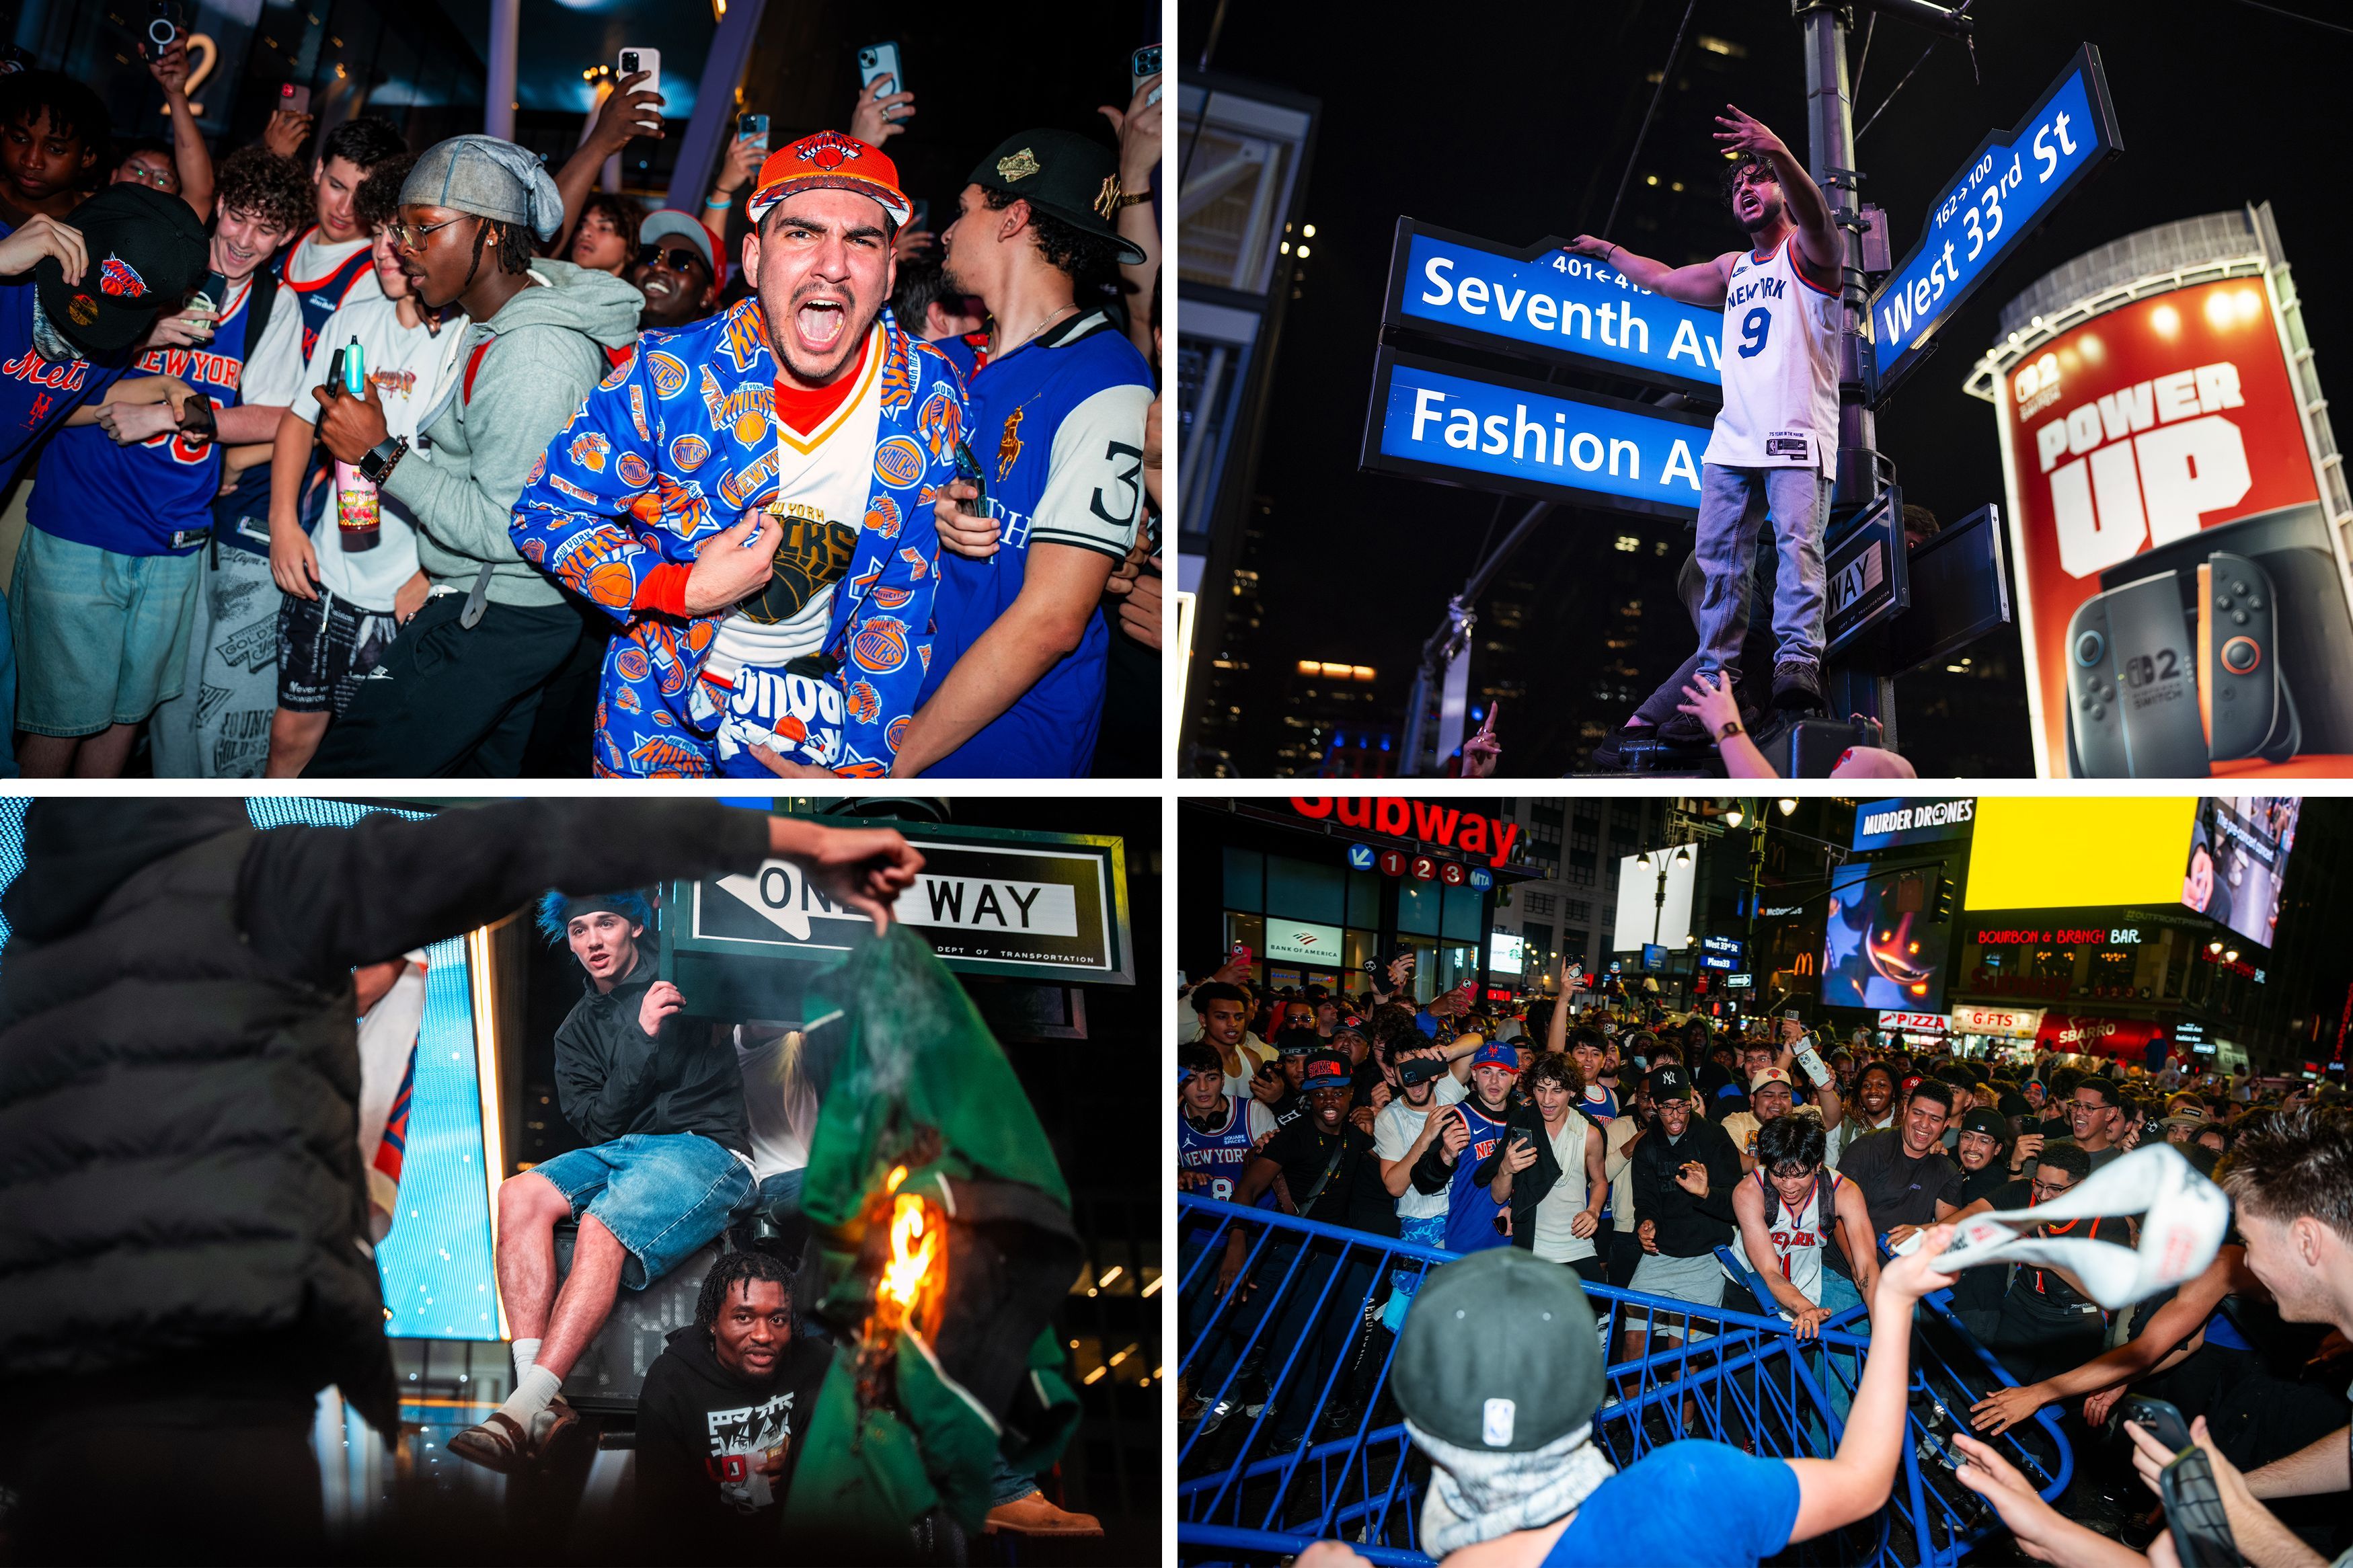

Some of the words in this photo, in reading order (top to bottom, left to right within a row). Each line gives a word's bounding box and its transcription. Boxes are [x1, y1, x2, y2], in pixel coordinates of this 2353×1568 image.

[160, 33, 217, 116] 2
[1935, 194, 1959, 230] 162
[1968, 153, 1993, 190] 100
[1883, 243, 1959, 347] West
[1968, 152, 2024, 262] 33rd
[2032, 110, 2078, 184] St
[102, 260, 145, 297] KNICKS
[1552, 256, 1592, 280] 401
[1614, 273, 1652, 295] 41
[1422, 256, 1650, 354] Seventh
[1728, 282, 1760, 311] NEW
[1761, 277, 1787, 300] RK
[1738, 307, 1772, 359] 9
[3, 344, 89, 391] Mets
[134, 348, 192, 378] EW
[2036, 362, 2245, 473] POWER
[572, 434, 609, 461] KNICKS
[675, 445, 705, 461] KNICKS
[1411, 388, 1640, 481] Fashion
[1660, 438, 1704, 491] A
[880, 447, 917, 478] KNICKS
[551, 476, 570, 492] NEW
[572, 485, 598, 504] YORK
[1090, 439, 1143, 526] 3
[341, 494, 356, 503] Kiwi
[2048, 415, 2252, 580] UP
[787, 503, 825, 522] YORK
[874, 497, 900, 538] KNICKS
[568, 530, 594, 549] YORK
[773, 516, 857, 567] CKS
[1826, 553, 1869, 616] WAY
[1858, 590, 1890, 616] TRANSPORTATION
[858, 633, 900, 663] KNICKS
[2156, 648, 2182, 681] 2
[289, 680, 316, 694] Never
[855, 682, 879, 722] KNICKS
[1863, 809, 1911, 836] MURDER
[2216, 808, 2229, 829] The
[1388, 856, 1397, 871] 1
[1419, 860, 1430, 878] 2
[1447, 865, 1459, 883] 3
[1470, 872, 1490, 888] MTA
[925, 879, 1041, 929] WAY
[1766, 907, 1802, 916] McDos
[1705, 939, 1720, 949] West
[1731, 943, 1738, 953] St
[1978, 930, 2039, 945] BOURBON
[2042, 933, 2052, 943] &
[2057, 929, 2106, 945] BRANCH
[2110, 929, 2142, 944] BAR
[937, 945, 964, 955] DEPT
[976, 949, 989, 957] OF
[1000, 951, 1095, 964] TRANSPORTATION
[1305, 949, 1338, 957] AMERICA
[1707, 957, 1730, 968] Plaza33
[1970, 966, 2073, 1002] Subway
[1897, 1013, 1945, 1029] PIZZA
[1973, 1012, 2013, 1027] GFTS
[2058, 1023, 2116, 1044] SBARRO
[1489, 1045, 1499, 1058] NY
[1662, 1070, 1676, 1085] NY
[1910, 1079, 1919, 1087] NY
[2184, 1108, 2200, 1116] Supreme
[1182, 1148, 1214, 1168] NEW
[1214, 1148, 1249, 1164] YOR
[1791, 1231, 1816, 1247] RK
